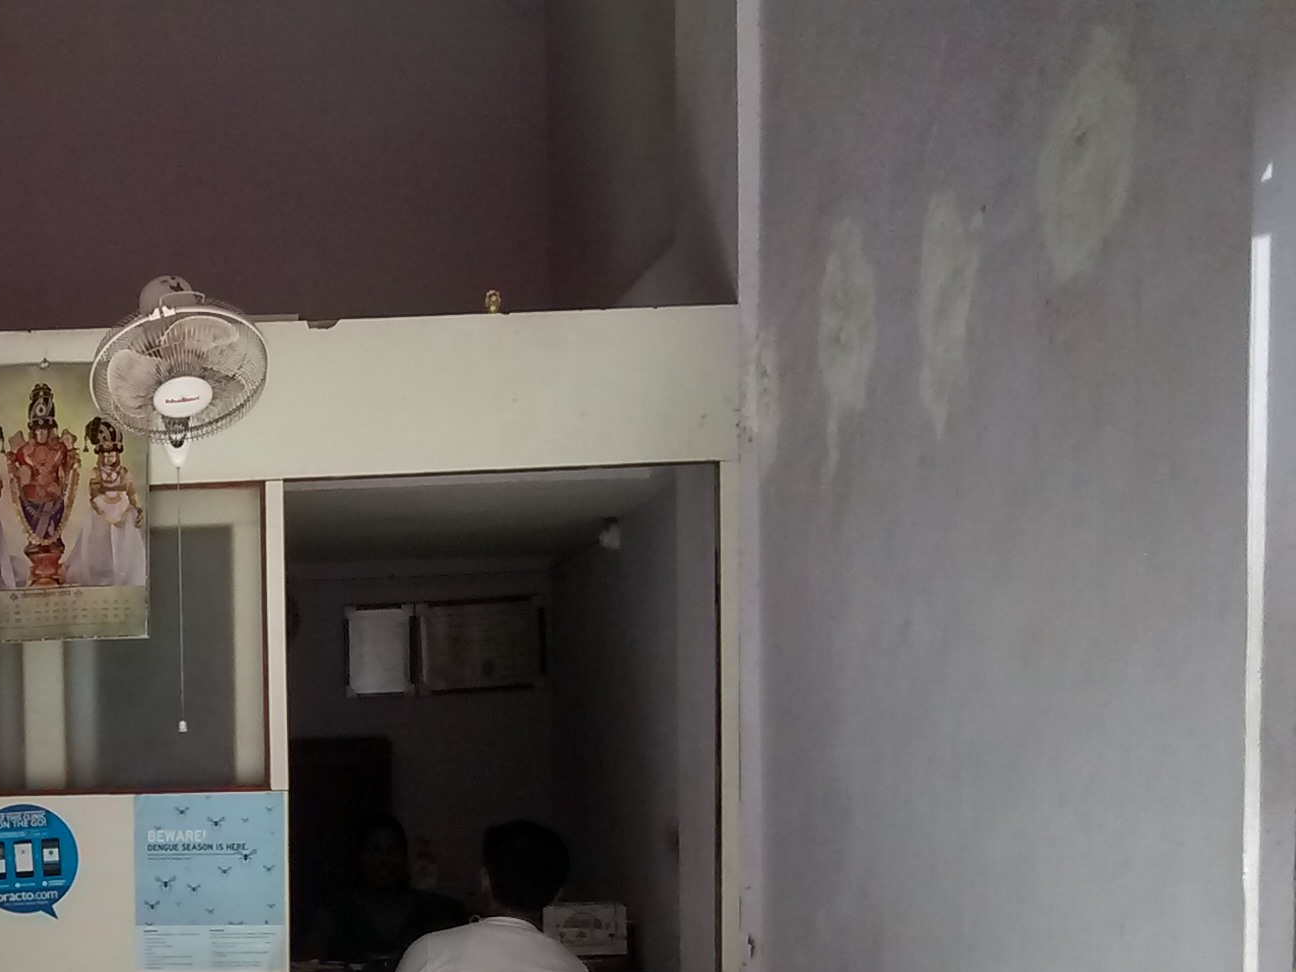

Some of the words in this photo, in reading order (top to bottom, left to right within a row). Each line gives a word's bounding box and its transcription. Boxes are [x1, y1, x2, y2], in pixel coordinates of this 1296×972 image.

[13, 820, 29, 828] THE
[30, 818, 47, 827] GO!
[147, 829, 206, 843] BEWARE!
[147, 843, 179, 852] DENGUE
[181, 842, 214, 852] SEASON
[215, 842, 224, 851] IS
[226, 842, 249, 852] HERE.
